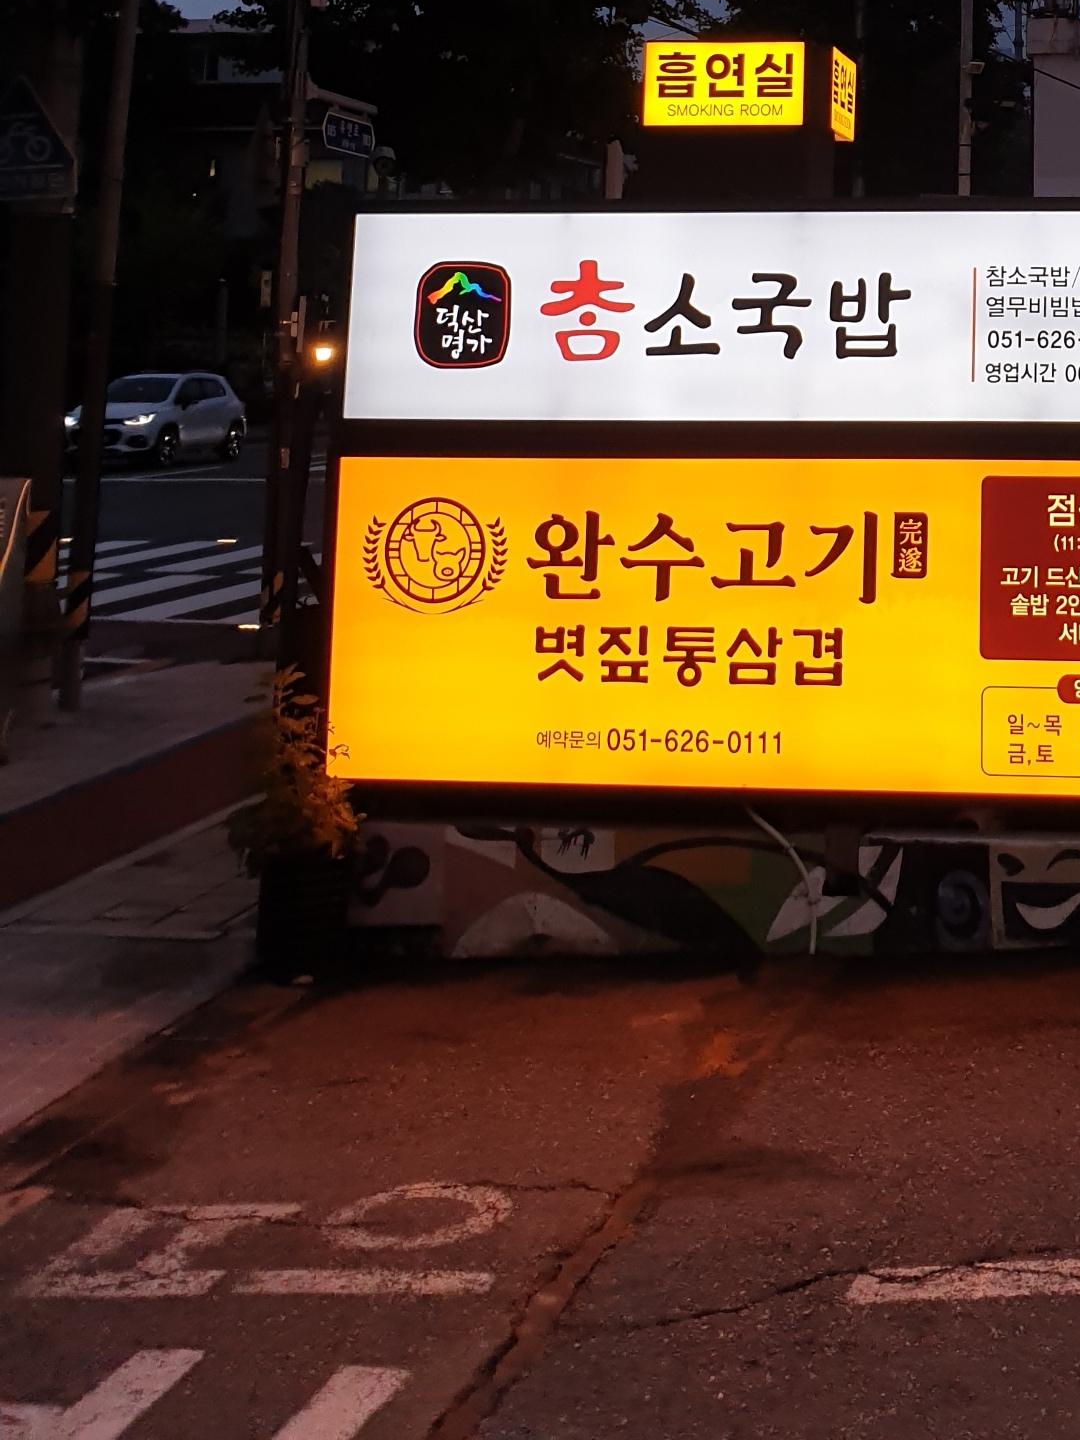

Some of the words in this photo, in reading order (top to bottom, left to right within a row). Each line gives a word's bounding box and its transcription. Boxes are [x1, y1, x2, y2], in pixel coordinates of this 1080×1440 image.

[657, 51, 793, 98] 흡연실
[667, 103, 734, 117] SMOKING
[740, 103, 783, 117] ROOM
[436, 304, 490, 333] 덕산
[441, 329, 493, 359] 명가
[985, 363, 1057, 383] 영업시간
[527, 511, 878, 604] 완수고기
[1000, 566, 1039, 588] 고기
[1010, 594, 1050, 616] 솥밥
[536, 624, 844, 687] 볏짚통삼겹
[1007, 713, 1063, 737] 일~목
[536, 730, 600, 750] 예약문의
[606, 728, 782, 755] 051-626-0111
[1007, 743, 1055, 766] 금,토
